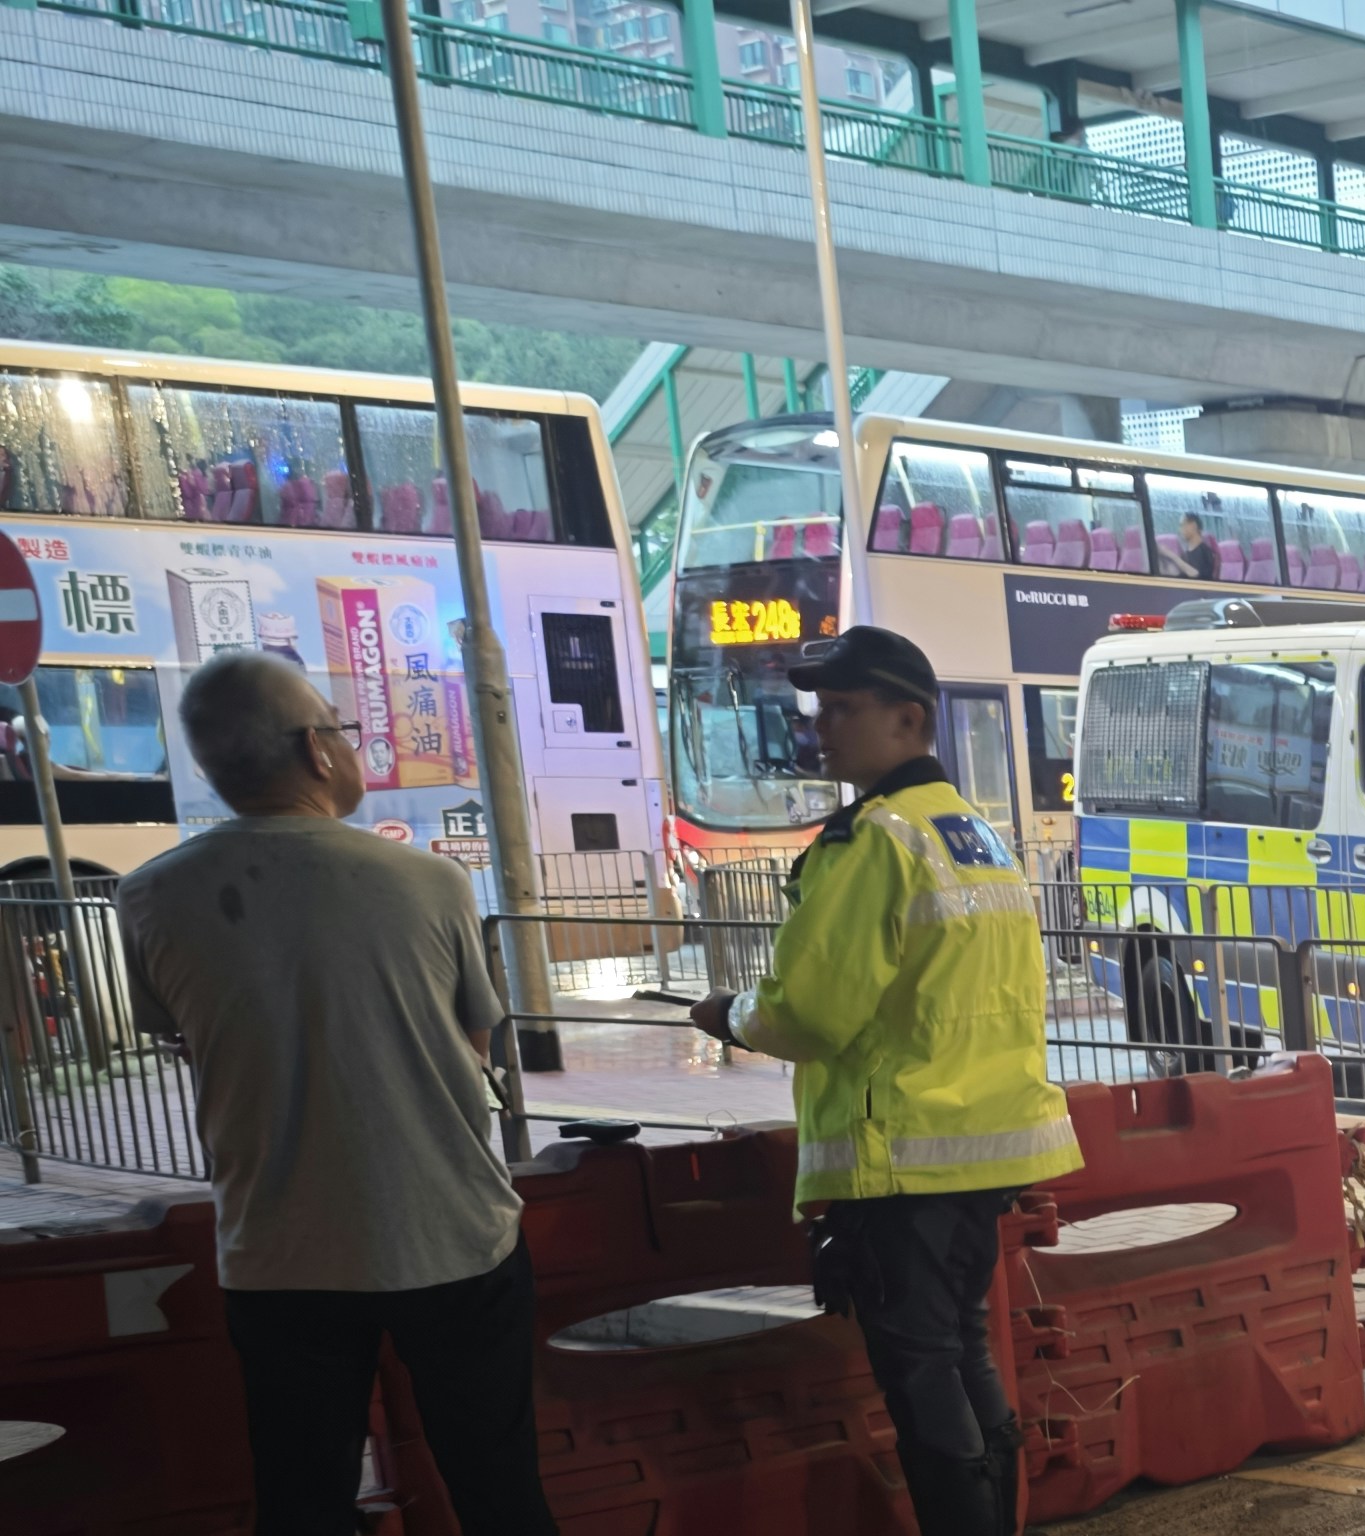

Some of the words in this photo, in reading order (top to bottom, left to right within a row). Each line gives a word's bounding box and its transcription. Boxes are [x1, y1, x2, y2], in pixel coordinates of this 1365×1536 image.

[1016, 589, 1067, 606] DeRUCCI
[356, 608, 391, 733] RUMAGON
[403, 652, 442, 757] 風痛油
